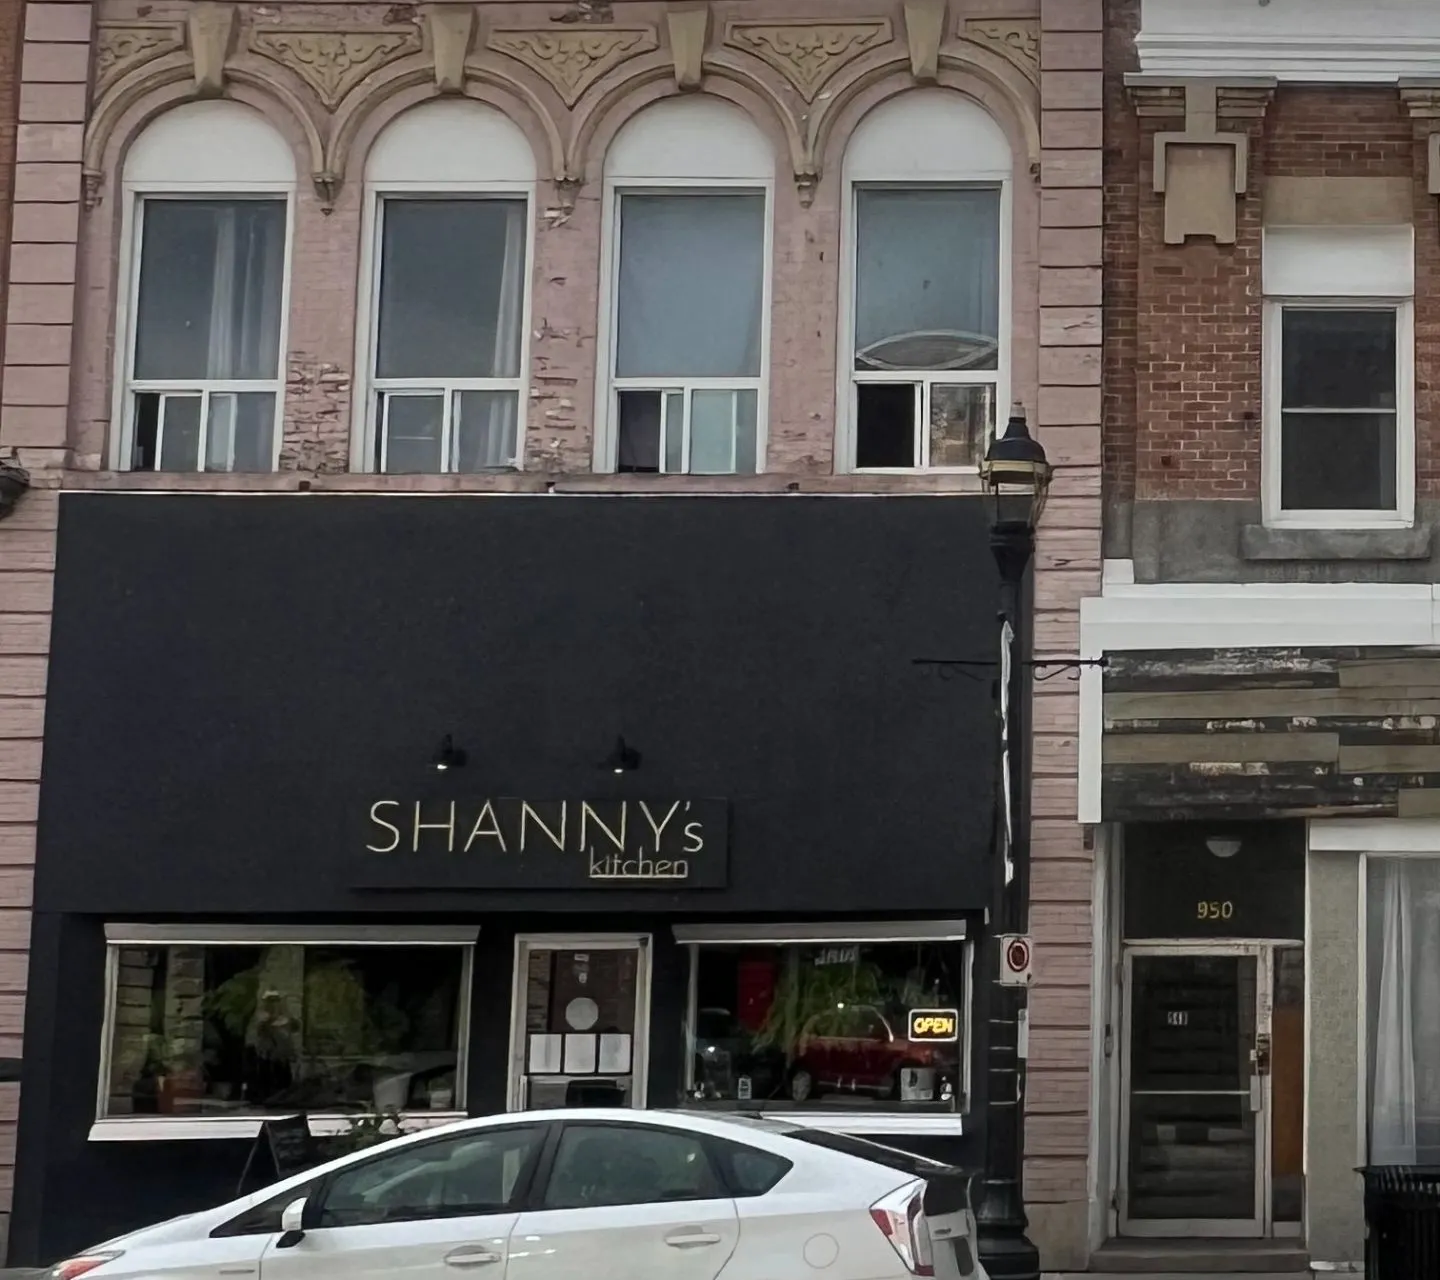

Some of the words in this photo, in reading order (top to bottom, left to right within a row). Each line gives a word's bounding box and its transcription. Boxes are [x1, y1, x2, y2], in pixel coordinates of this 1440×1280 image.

[365, 800, 704, 853] SHANNY's
[589, 846, 689, 877] kitchen
[1197, 900, 1234, 919] 950
[913, 1017, 953, 1034] OPEN
